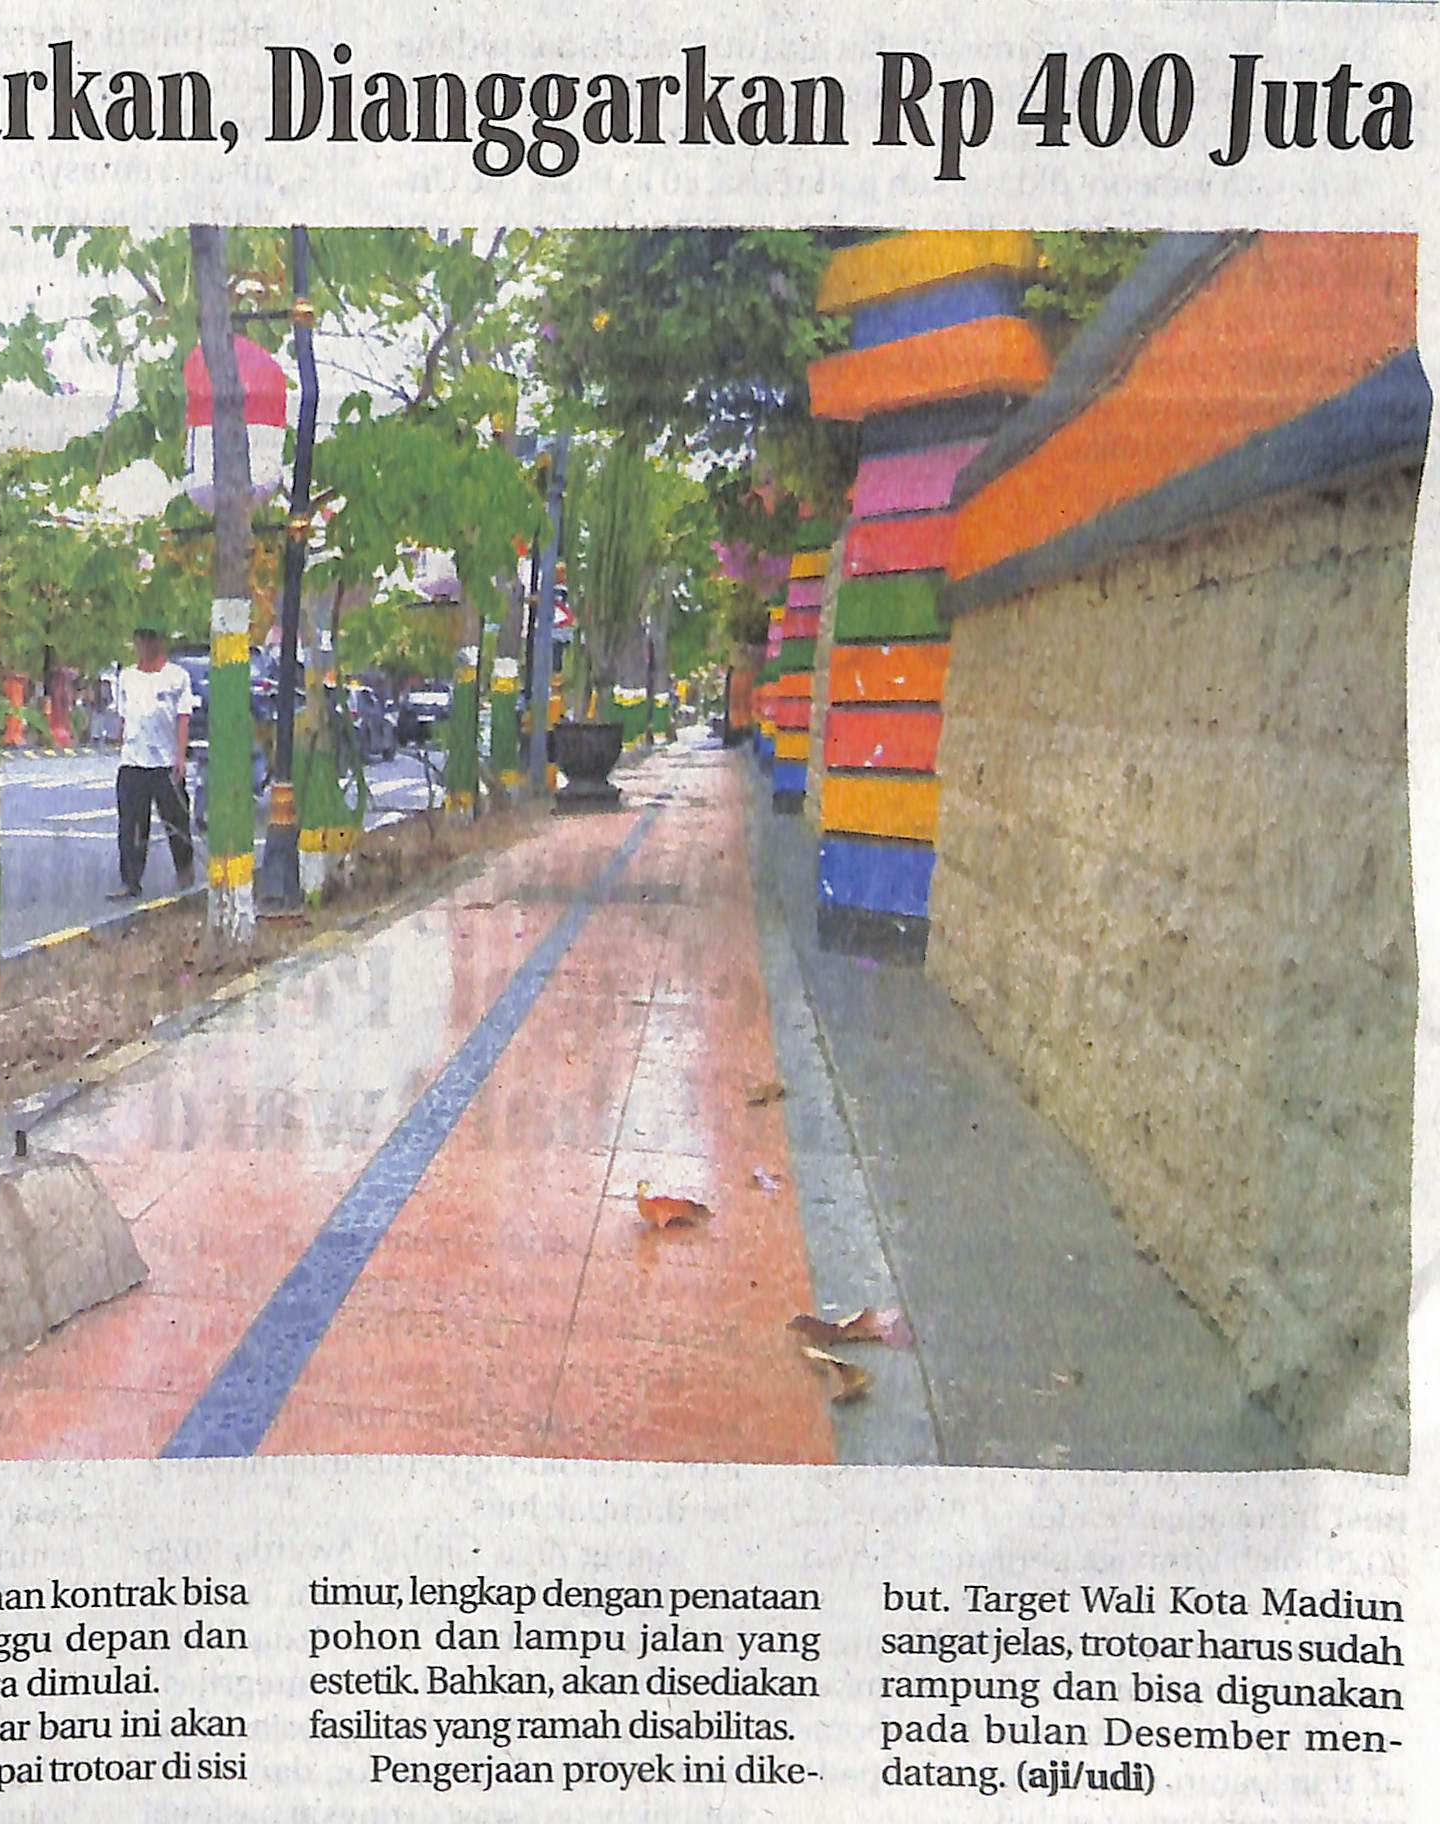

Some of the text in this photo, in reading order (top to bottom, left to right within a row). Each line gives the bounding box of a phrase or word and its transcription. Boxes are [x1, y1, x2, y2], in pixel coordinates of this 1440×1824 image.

[264, 43, 850, 178] Dianggarkan
[872, 51, 994, 181] Rp
[1017, 52, 1195, 149] 400
[1208, 54, 1414, 167] Juta
[50, 1576, 177, 1609] kontrak
[182, 1576, 249, 1606] bisa
[308, 1575, 822, 1617] timur, lengkap dengan penataan
[882, 1581, 1405, 1623] but. Target Wali Kota Madiun
[65, 1622, 171, 1660] depan
[184, 1619, 249, 1650] dan
[309, 1620, 821, 1662] pohon dan lampu jalan yang
[881, 1626, 1405, 1667] sangat jelas, trotoar harus sudah
[26, 1665, 159, 1697] dimulai.
[310, 1664, 820, 1699] estetik. Bahkan, akan disediakan
[880, 1670, 1404, 1715] rampung dan bisa digunakan
[38, 1710, 113, 1741] baru
[120, 1708, 162, 1738] ini
[170, 1707, 248, 1737] akan
[309, 1708, 795, 1748] fasilitas yang ramah disabilitas.
[880, 1713, 1403, 1753] pada bulan Desember men-
[48, 1756, 157, 1783] trotoar
[162, 1751, 192, 1780] di
[197, 1759, 248, 1780] sisi
[370, 1753, 818, 1792] Pengerjaan proyek ini dike-
[882, 1756, 1155, 1797] datang. (aji/udi)
